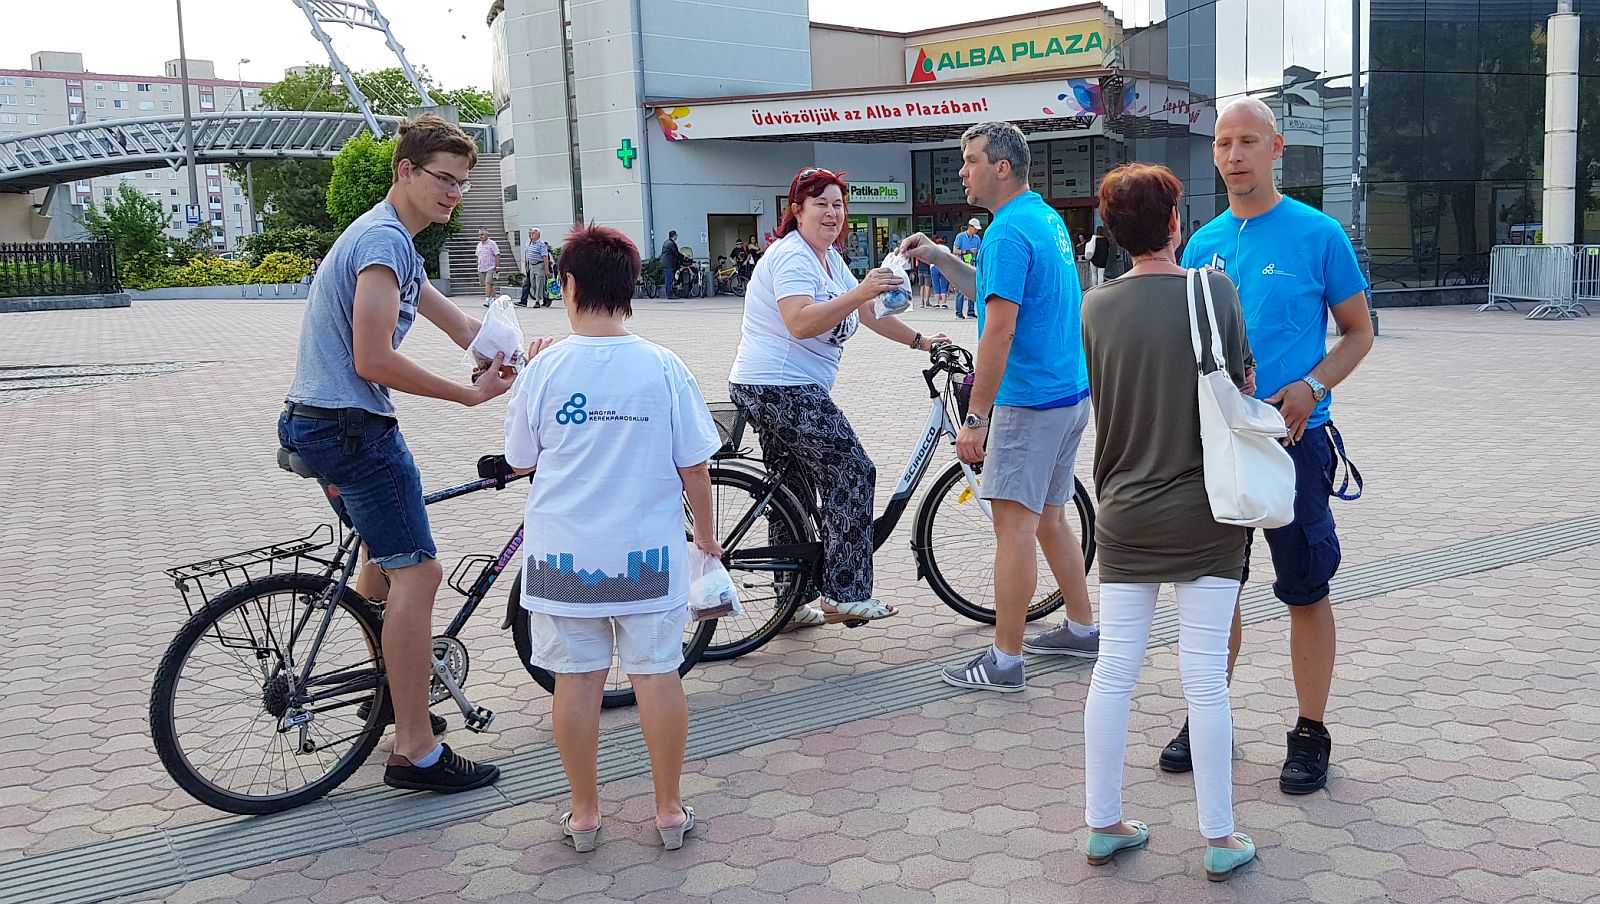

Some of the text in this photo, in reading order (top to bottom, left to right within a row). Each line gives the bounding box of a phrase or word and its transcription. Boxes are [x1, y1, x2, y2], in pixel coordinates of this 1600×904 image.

[937, 32, 1102, 71] ALBA PLAZA
[752, 97, 988, 126] Üdvözöljük az Alba Plazában!
[850, 185, 898, 197] PatikaPlus
[903, 426, 937, 484] SCIROCCO
